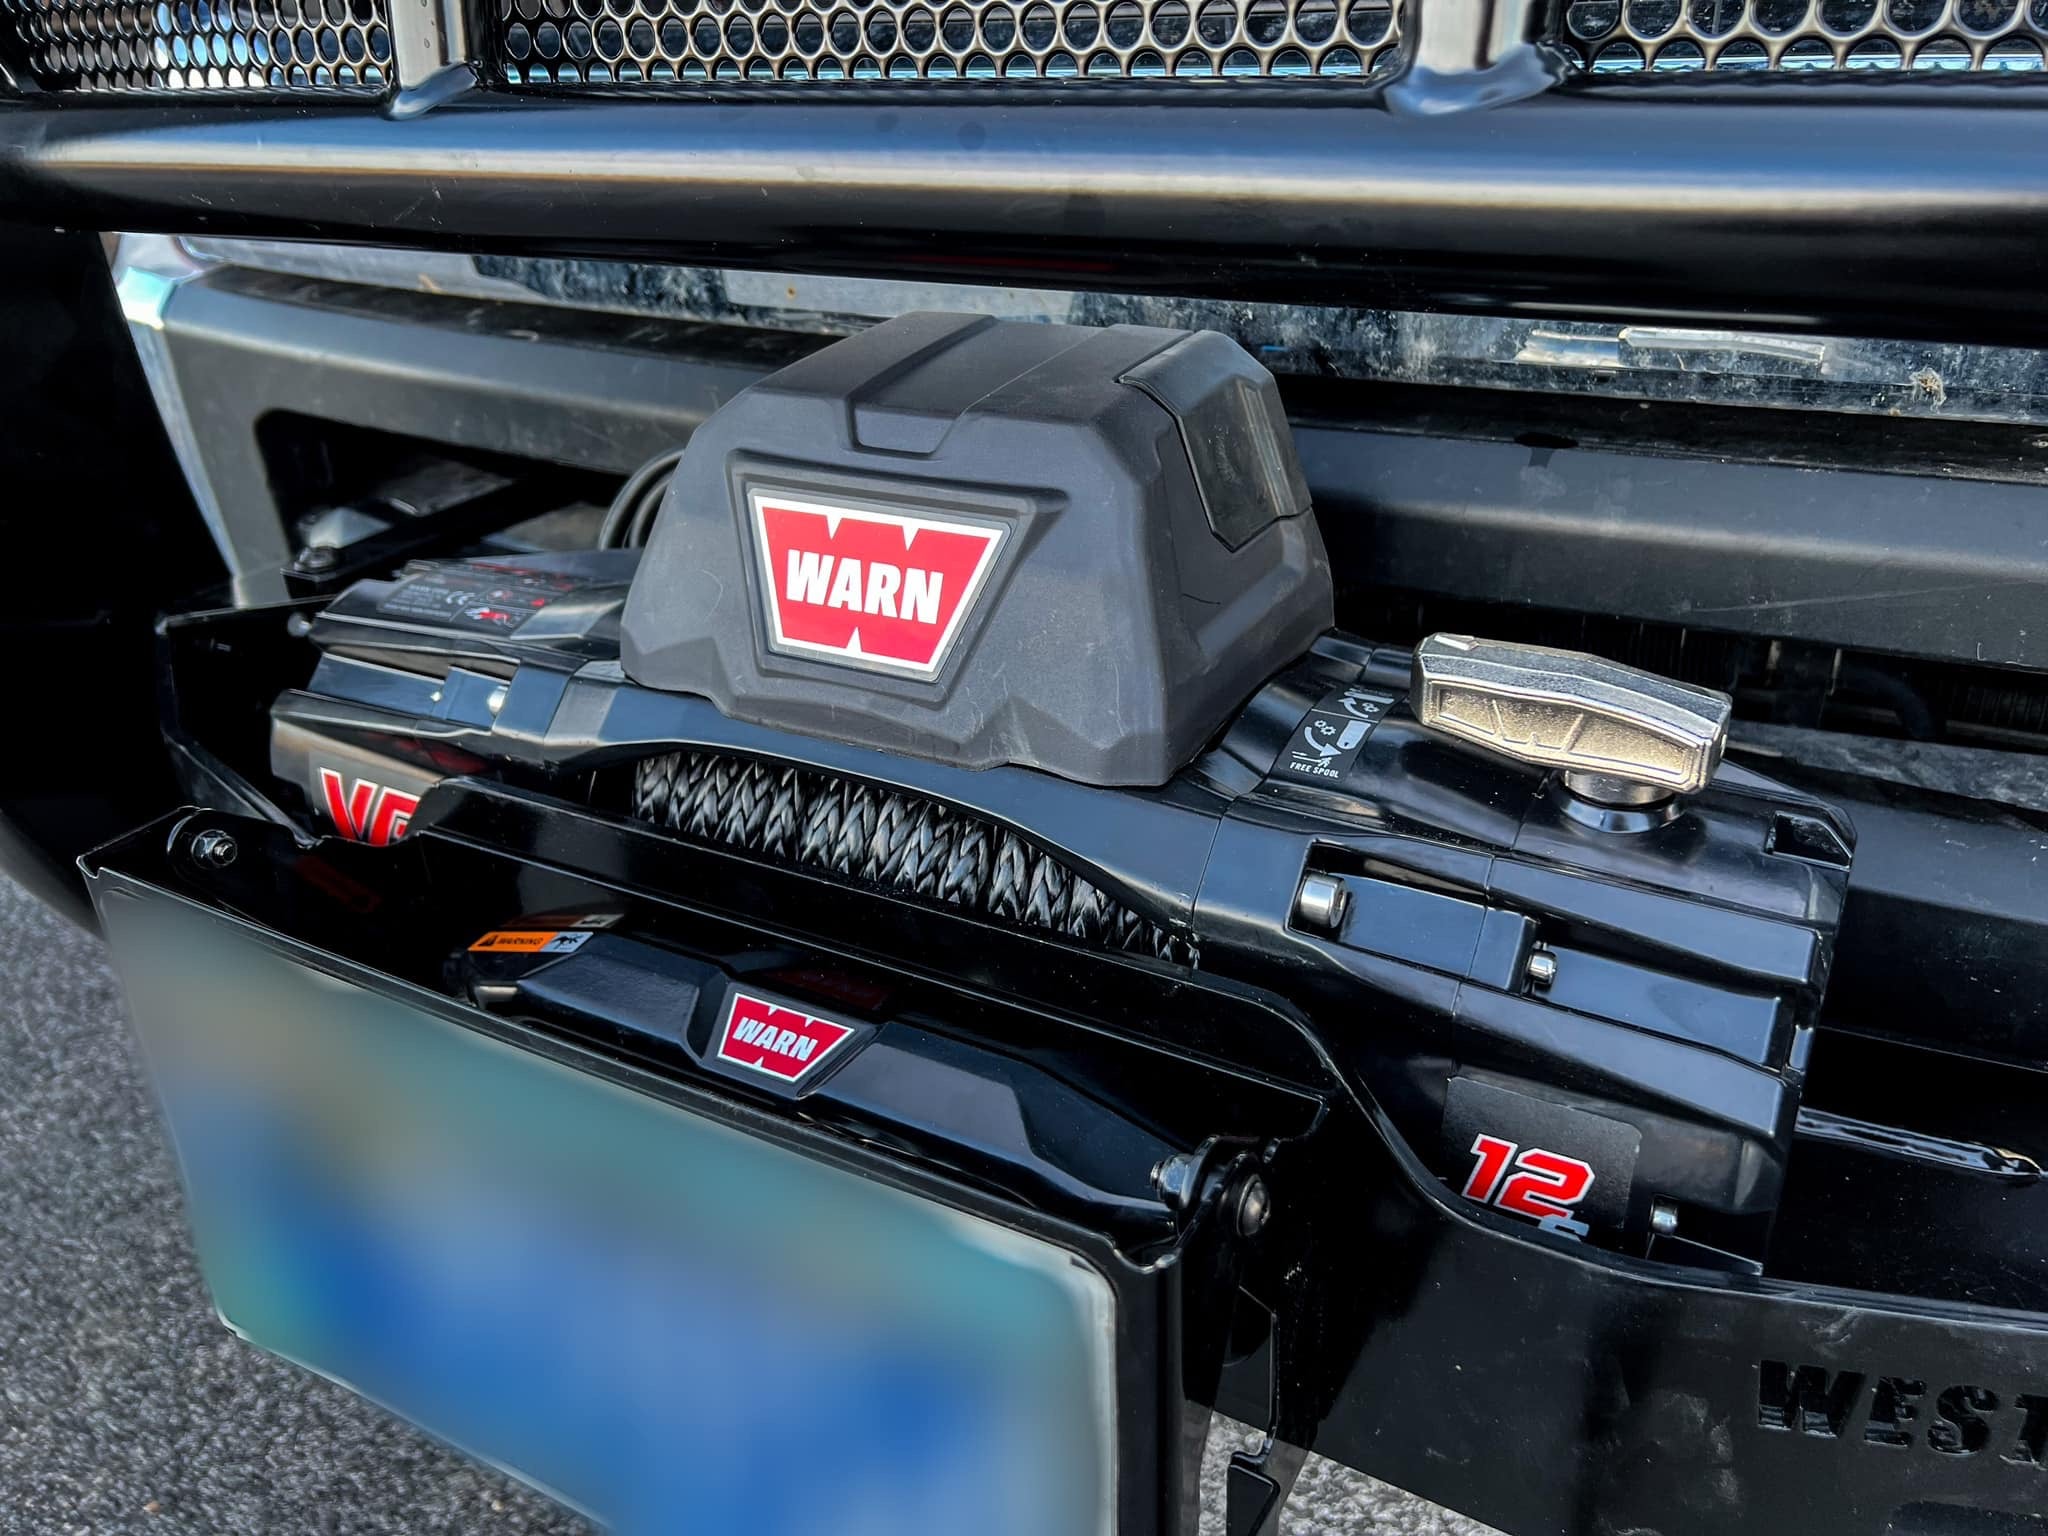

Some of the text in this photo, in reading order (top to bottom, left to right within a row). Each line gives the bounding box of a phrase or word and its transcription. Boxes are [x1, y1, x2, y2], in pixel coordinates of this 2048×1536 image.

[786, 549, 943, 624] WARN
[1290, 762, 1340, 778] FREE SPOOL
[732, 1017, 818, 1061] WARN
[1461, 1133, 1595, 1221] 12
